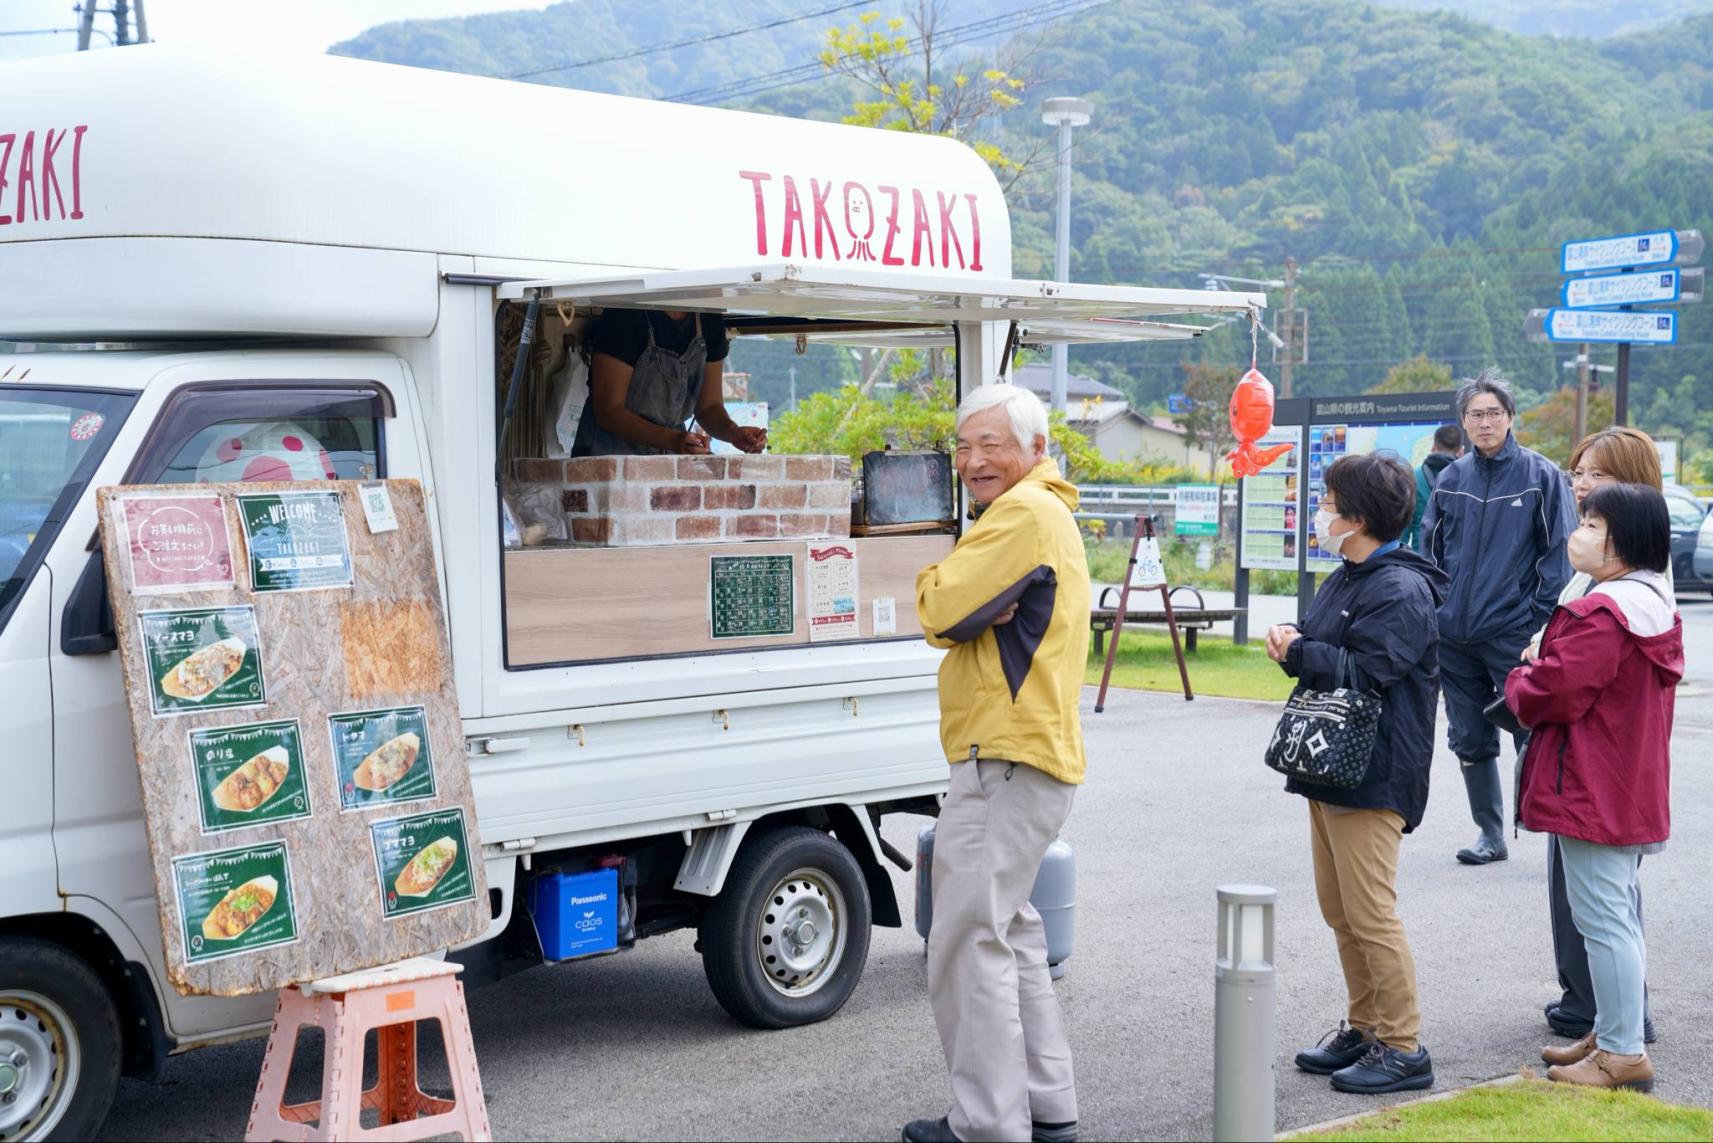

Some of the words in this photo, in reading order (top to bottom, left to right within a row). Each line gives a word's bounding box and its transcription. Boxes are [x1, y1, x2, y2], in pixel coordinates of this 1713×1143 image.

[0, 125, 88, 225] ZAKI
[739, 170, 983, 272] TAKOZAKI
[1377, 405, 1398, 414] Toyama
[1398, 404, 1417, 412] Tourist
[1417, 402, 1450, 411] Information
[268, 502, 318, 525] WELCOME
[571, 891, 607, 906] Panasonic
